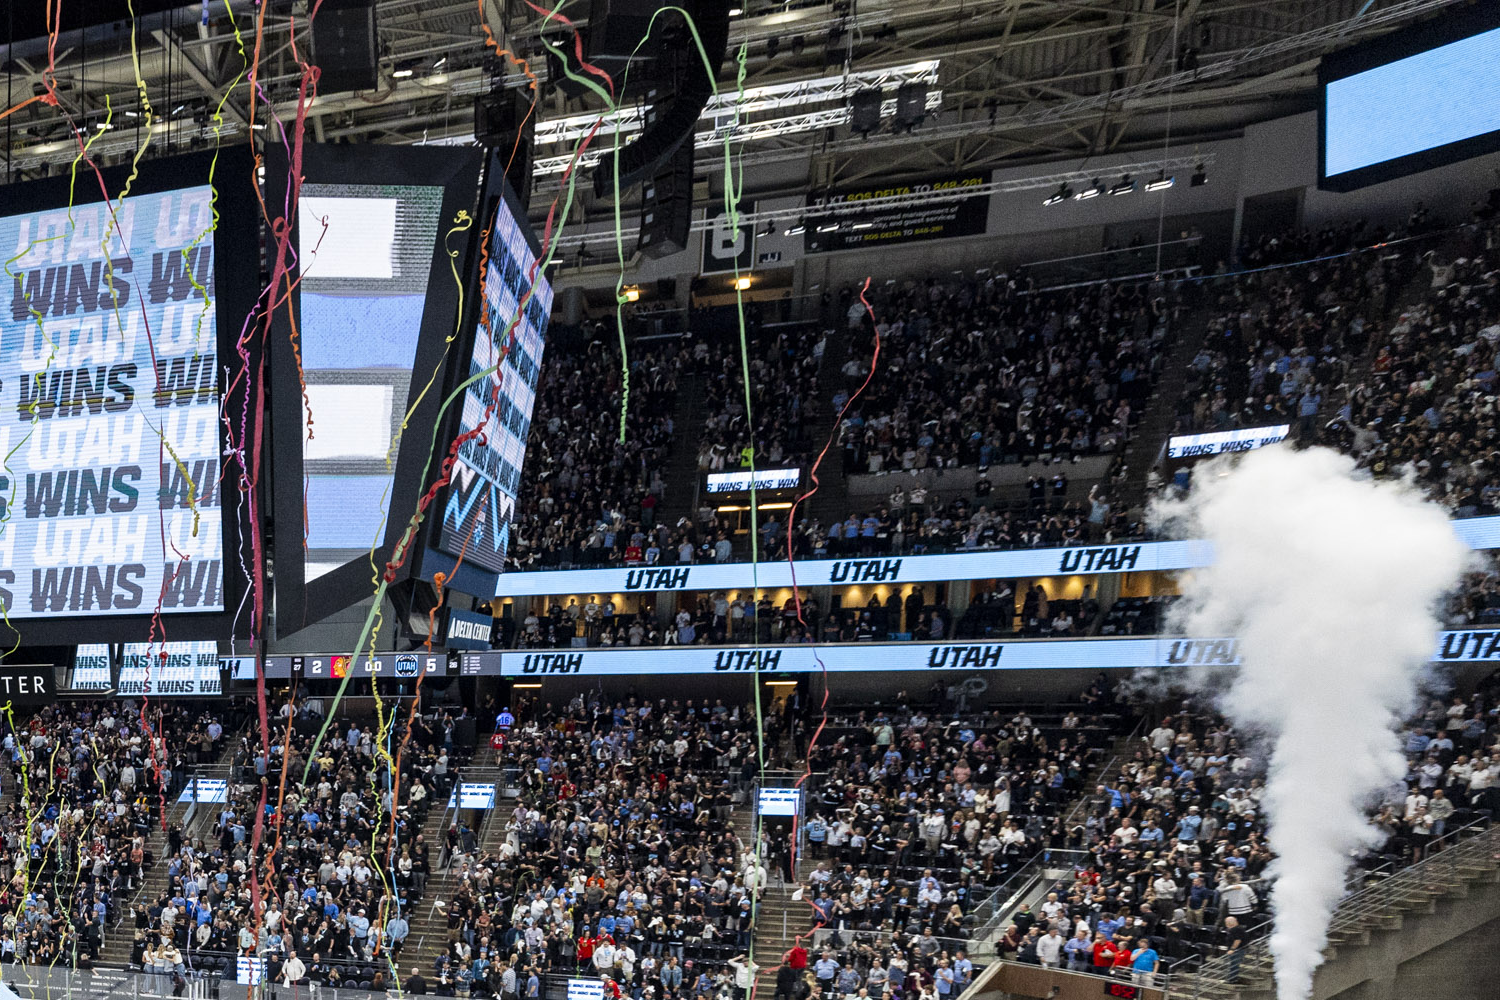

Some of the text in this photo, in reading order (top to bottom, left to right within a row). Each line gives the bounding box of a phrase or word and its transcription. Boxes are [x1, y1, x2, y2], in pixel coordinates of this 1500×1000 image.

[815, 194, 844, 206] TXT
[913, 185, 931, 193] TO
[15, 201, 136, 269] UTAH
[10, 257, 134, 322] WINS
[18, 310, 141, 371] UTAH
[16, 362, 138, 422] WINS
[25, 414, 147, 471] UTAH
[1181, 438, 1254, 456] WINS WINS
[23, 465, 142, 518] WINS
[717, 479, 774, 492] WINS WINS
[31, 514, 149, 567] UTAH
[829, 559, 902, 583] UTAH
[1058, 546, 1142, 574] UTAH
[29, 563, 147, 612] WINS
[624, 567, 691, 590] UTAH
[455, 620, 492, 642] DELTA CENTER
[154, 653, 192, 667] WINS
[312, 661, 322, 674] 2
[364, 660, 382, 673] 00
[397, 660, 417, 673] UTAH
[426, 659, 437, 672] 5
[522, 653, 584, 674] UTAH
[713, 650, 783, 671] UTAH
[927, 645, 1003, 668] UTAH
[156, 680, 195, 693] WINS
